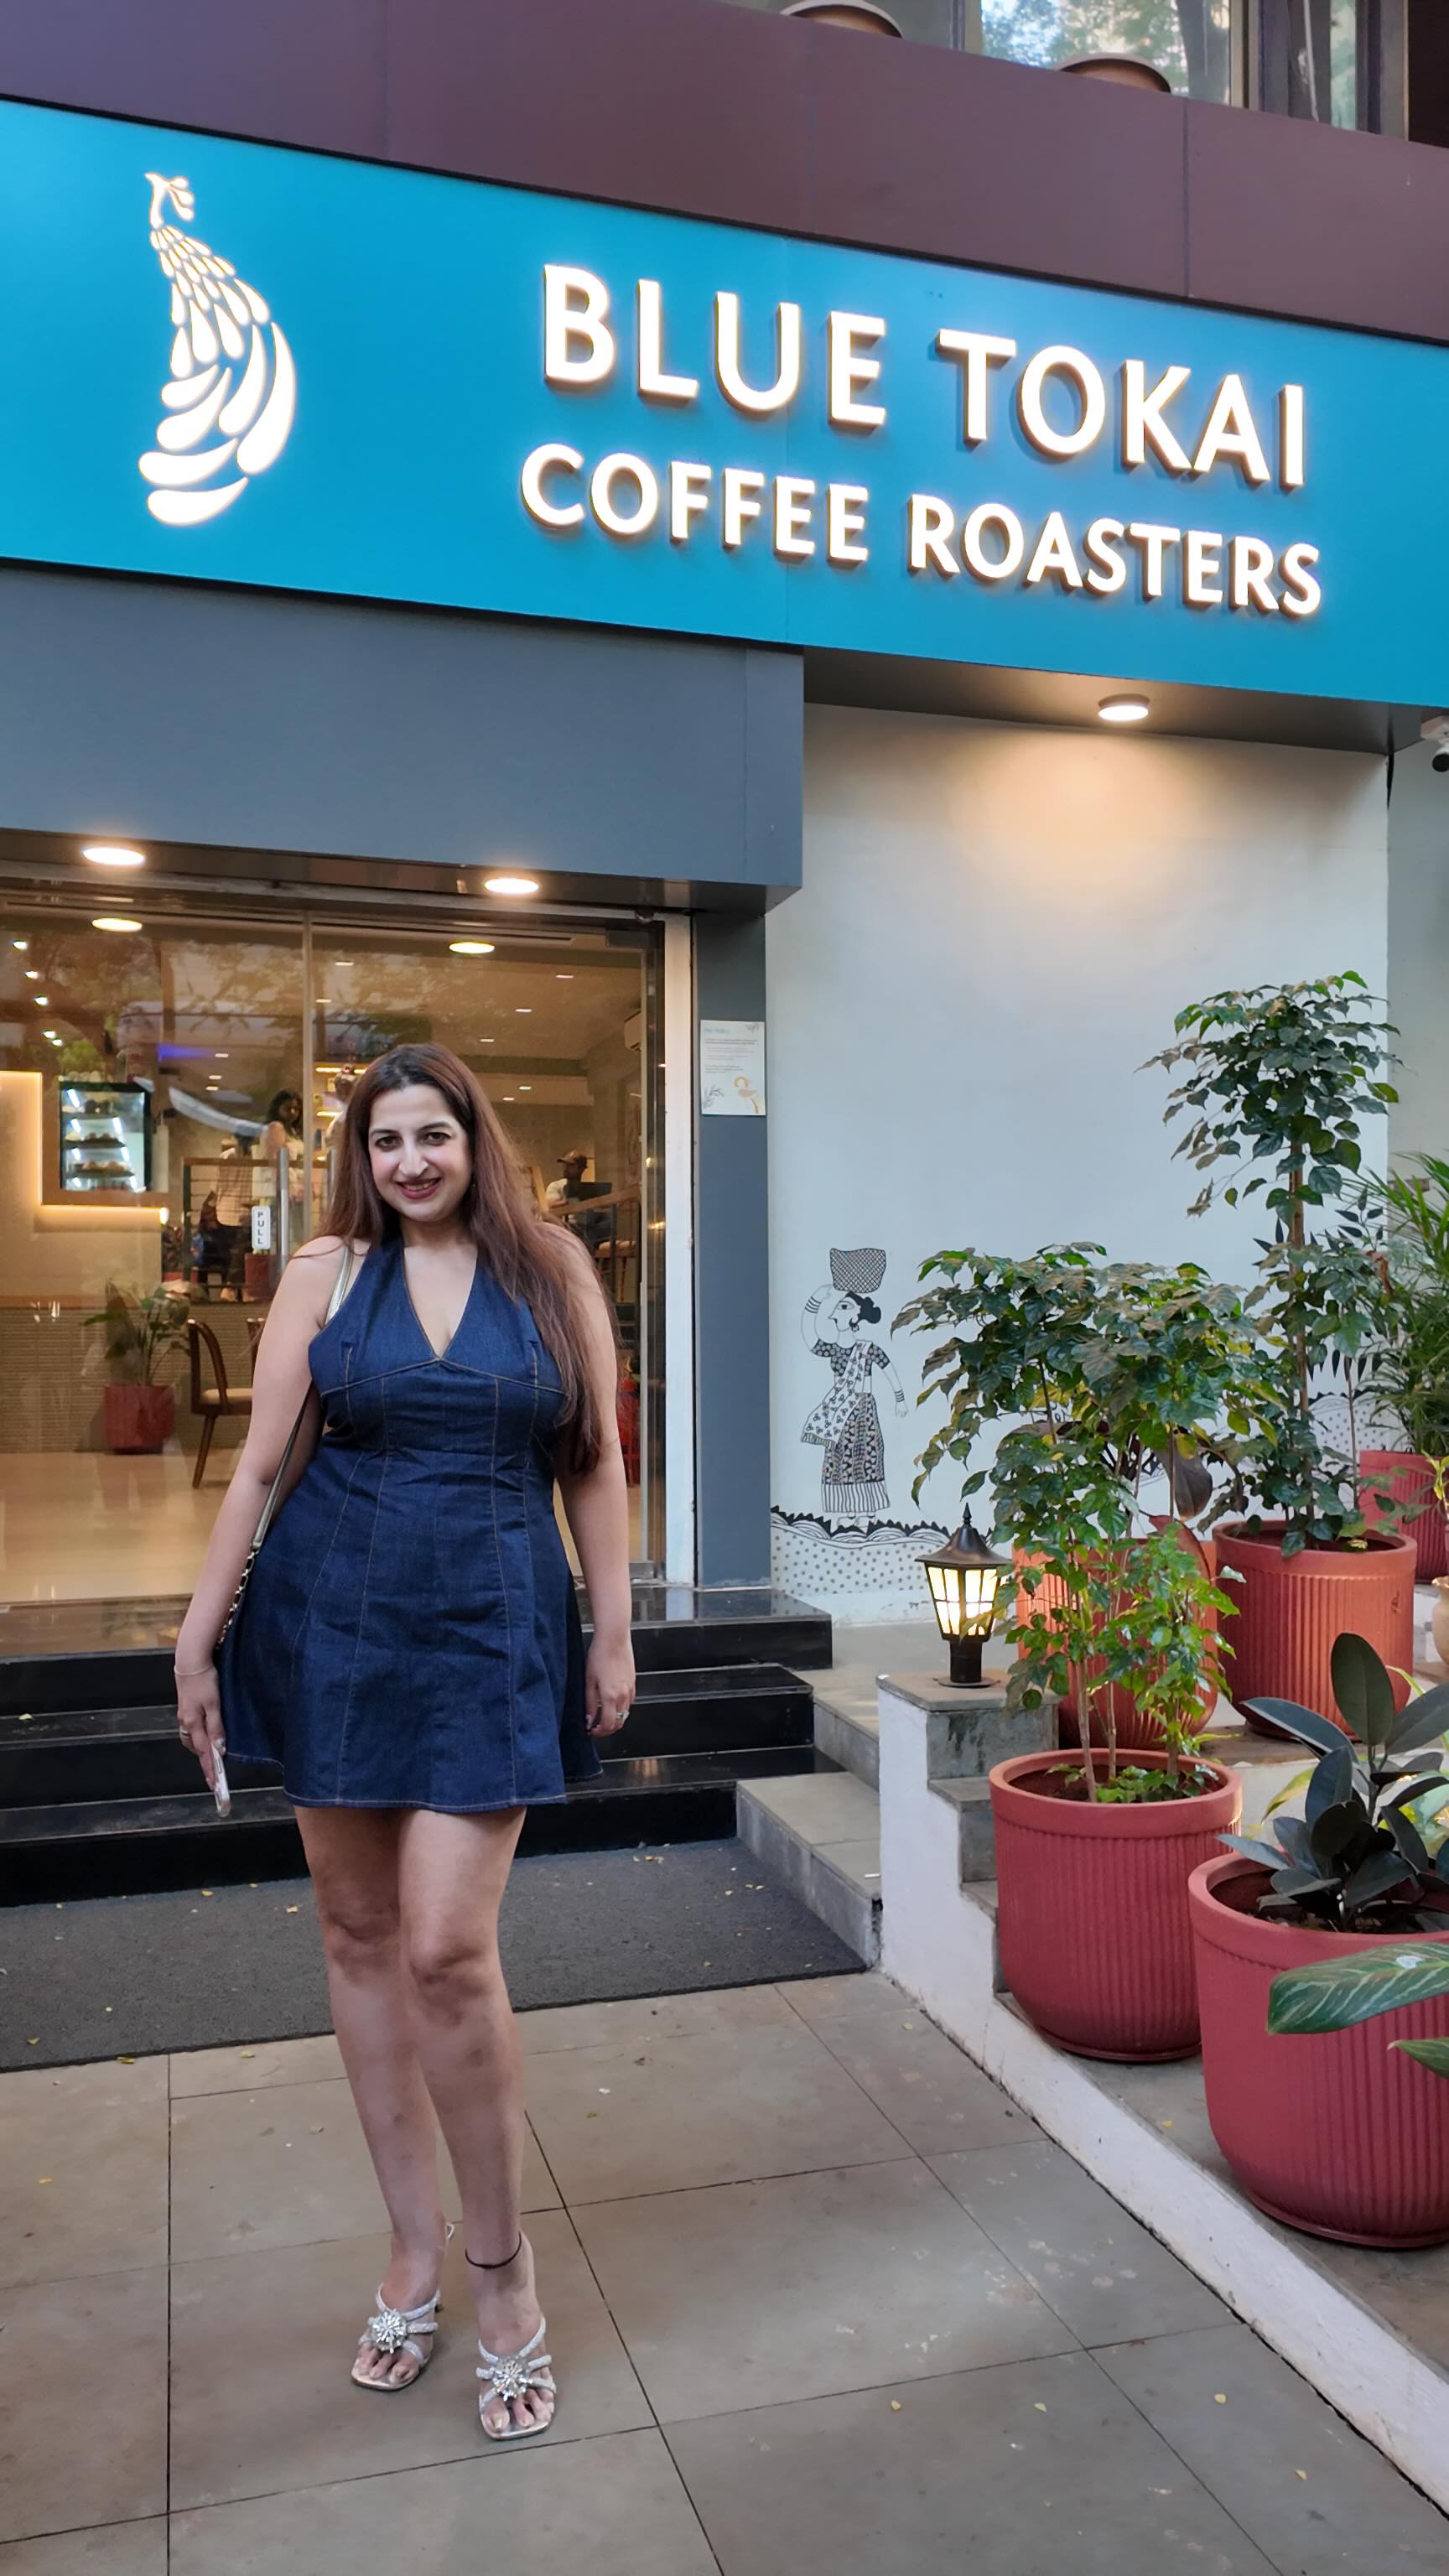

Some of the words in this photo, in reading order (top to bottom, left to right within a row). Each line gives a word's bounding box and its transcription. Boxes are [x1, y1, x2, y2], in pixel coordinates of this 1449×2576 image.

[542, 262, 888, 430] BLUE
[936, 327, 1307, 488] TOKAI
[520, 443, 870, 565] COFFEE
[908, 493, 1322, 617] ROASTERS
